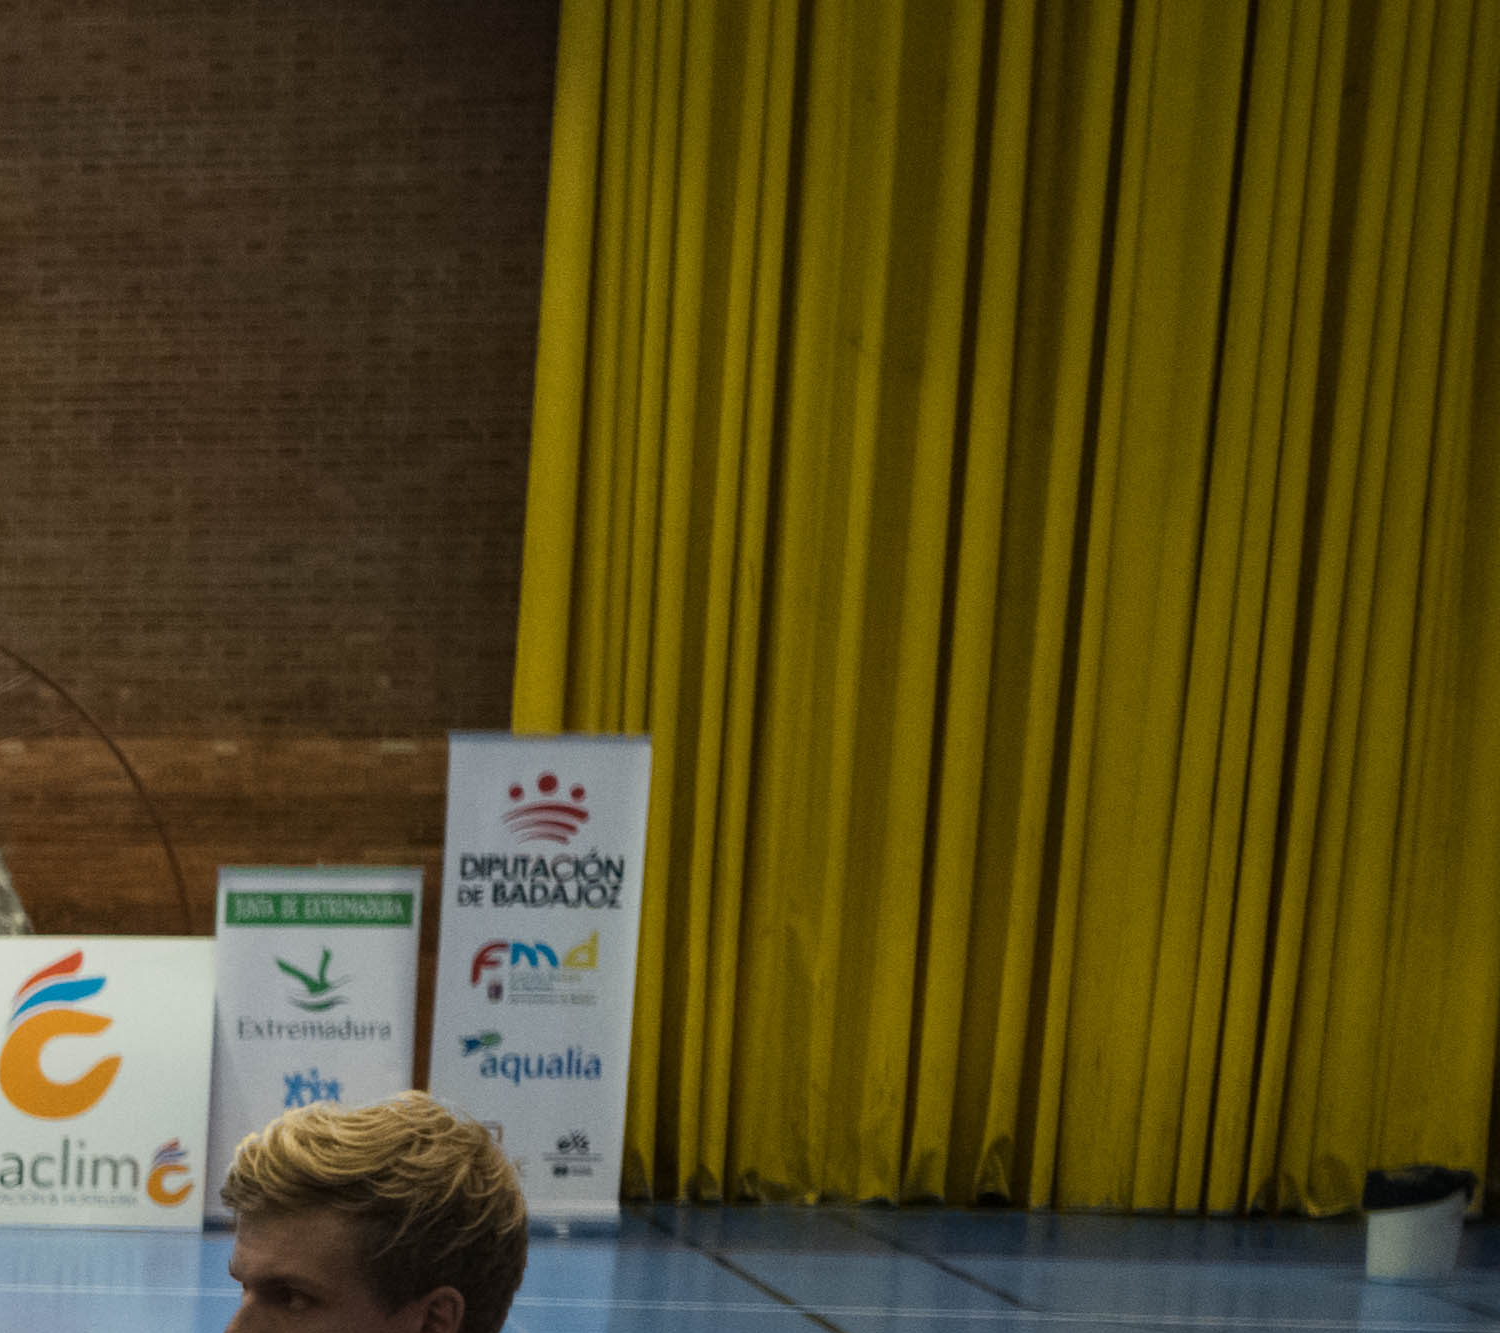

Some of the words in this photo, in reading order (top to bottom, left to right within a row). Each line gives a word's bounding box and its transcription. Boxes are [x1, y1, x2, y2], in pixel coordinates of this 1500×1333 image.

[460, 848, 625, 882] DIPUTACIÓN
[457, 884, 485, 906] DE
[491, 882, 623, 909] BADAJOZ
[237, 1015, 392, 1041] Extremadura
[480, 1048, 602, 1087] aqualia
